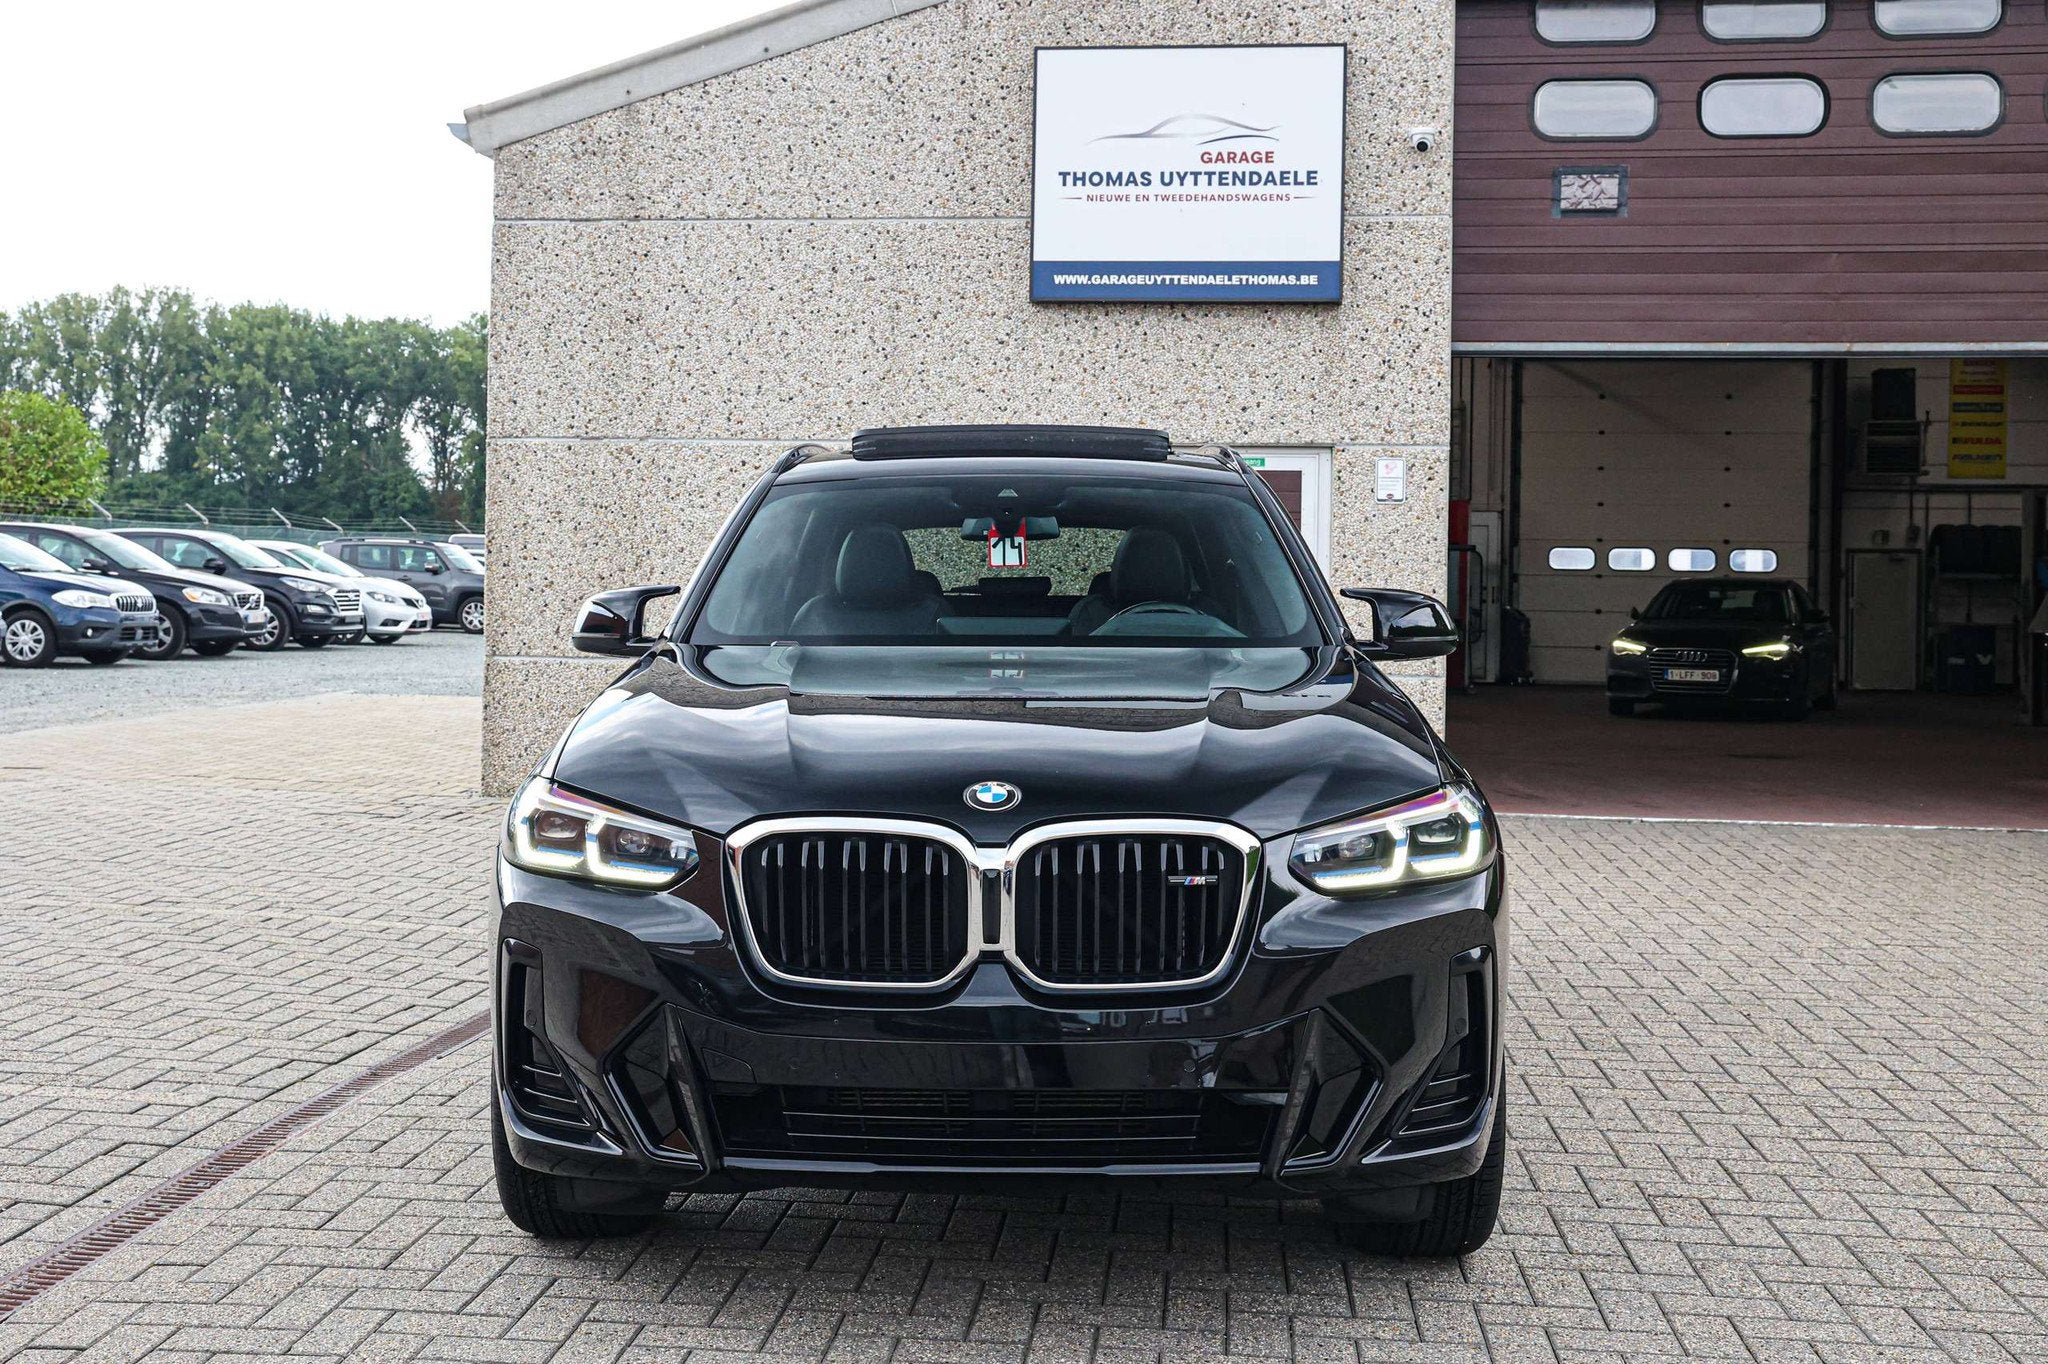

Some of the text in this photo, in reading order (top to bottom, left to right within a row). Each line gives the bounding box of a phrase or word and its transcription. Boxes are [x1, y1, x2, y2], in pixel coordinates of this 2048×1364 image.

[1200, 151, 1275, 164] GARAGE
[1058, 170, 1318, 187] THOMAS UYTTENDAELE
[1086, 193, 1291, 202] NIEUWE EN TWEEDEHANDSWAGENS
[1053, 274, 1319, 286] WWW.GARAGEUYTTENDAELETHOMAS.BE
